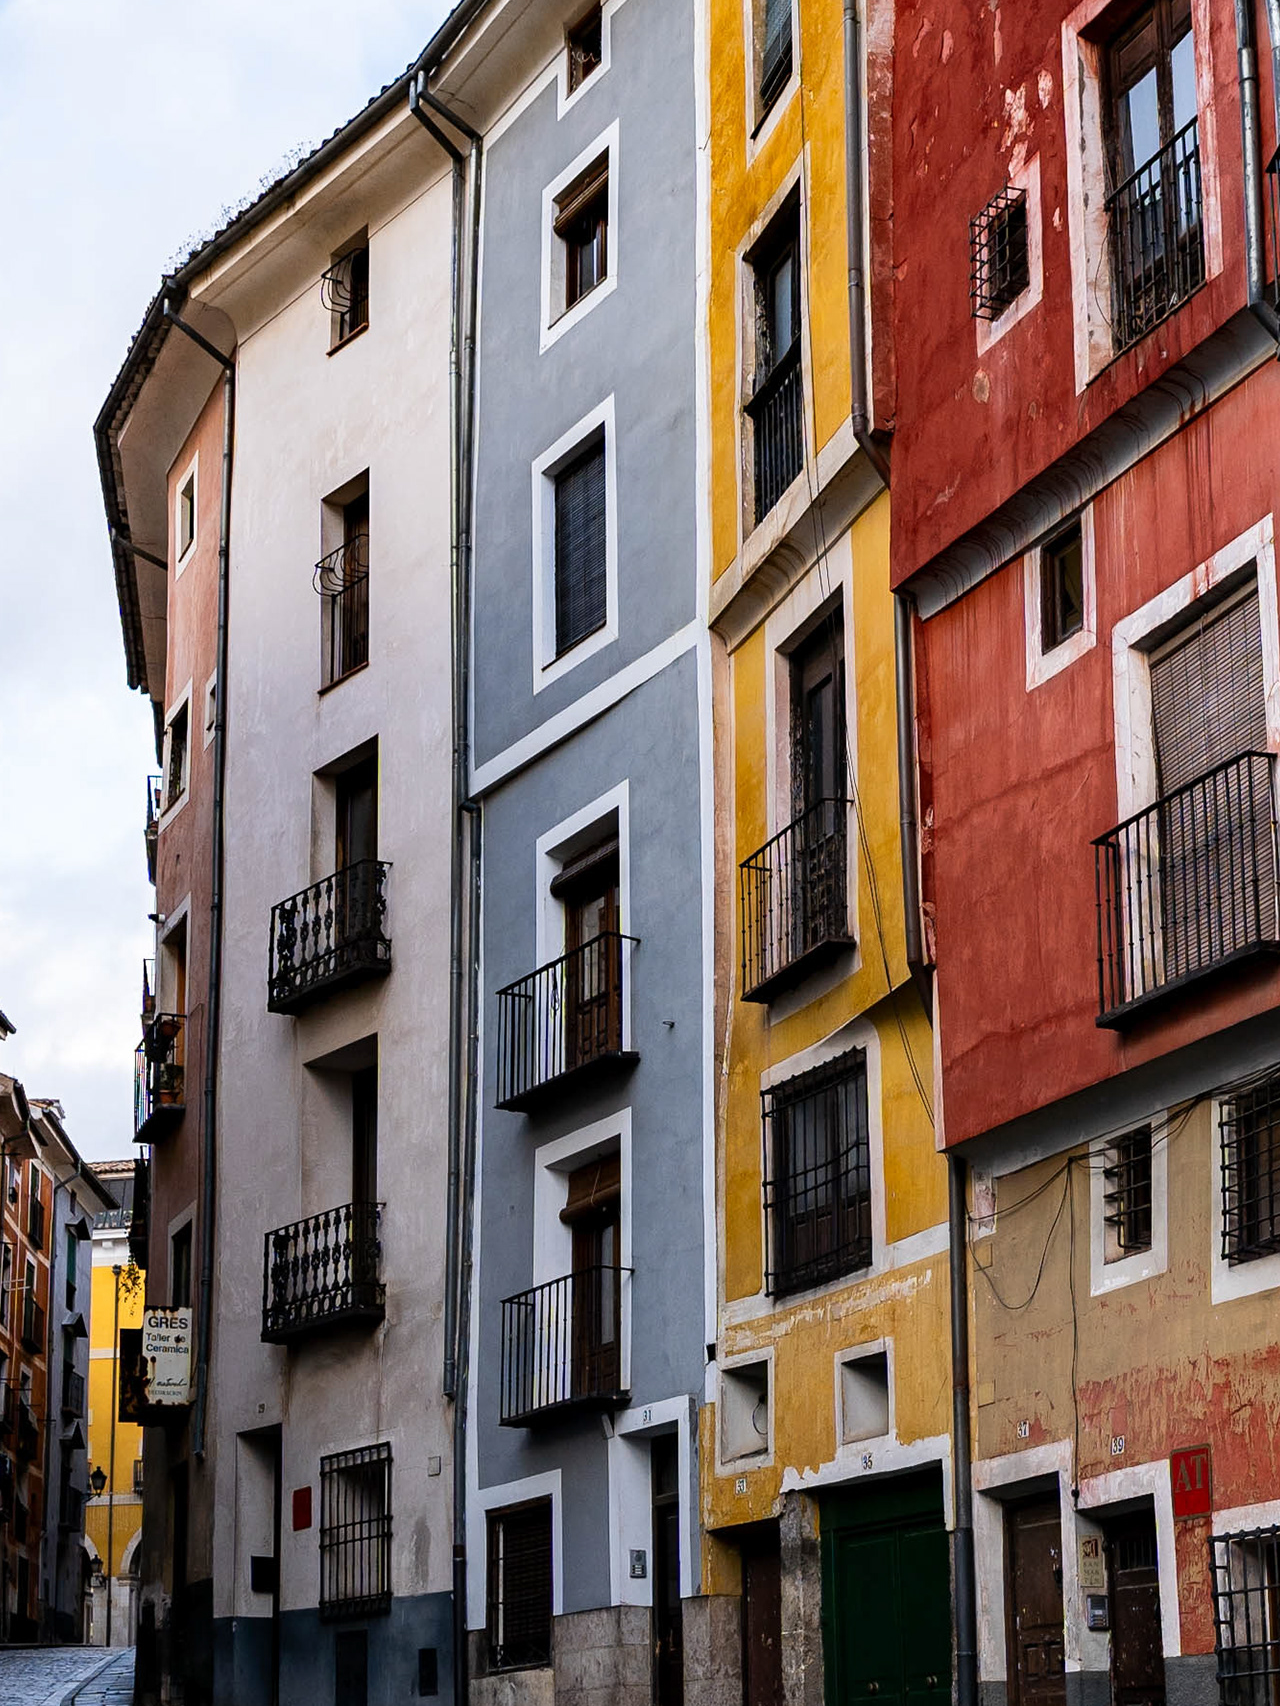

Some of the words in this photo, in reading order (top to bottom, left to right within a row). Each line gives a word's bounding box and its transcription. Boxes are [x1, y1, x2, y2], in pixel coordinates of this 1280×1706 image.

[148, 1316, 188, 1330] GRES
[146, 1332, 171, 1342] Taller
[643, 1409, 652, 1422] 31
[1017, 1422, 1028, 1438] 37
[1113, 1437, 1123, 1453] 39
[863, 1455, 873, 1470] 35
[1175, 1453, 1207, 1493] AT
